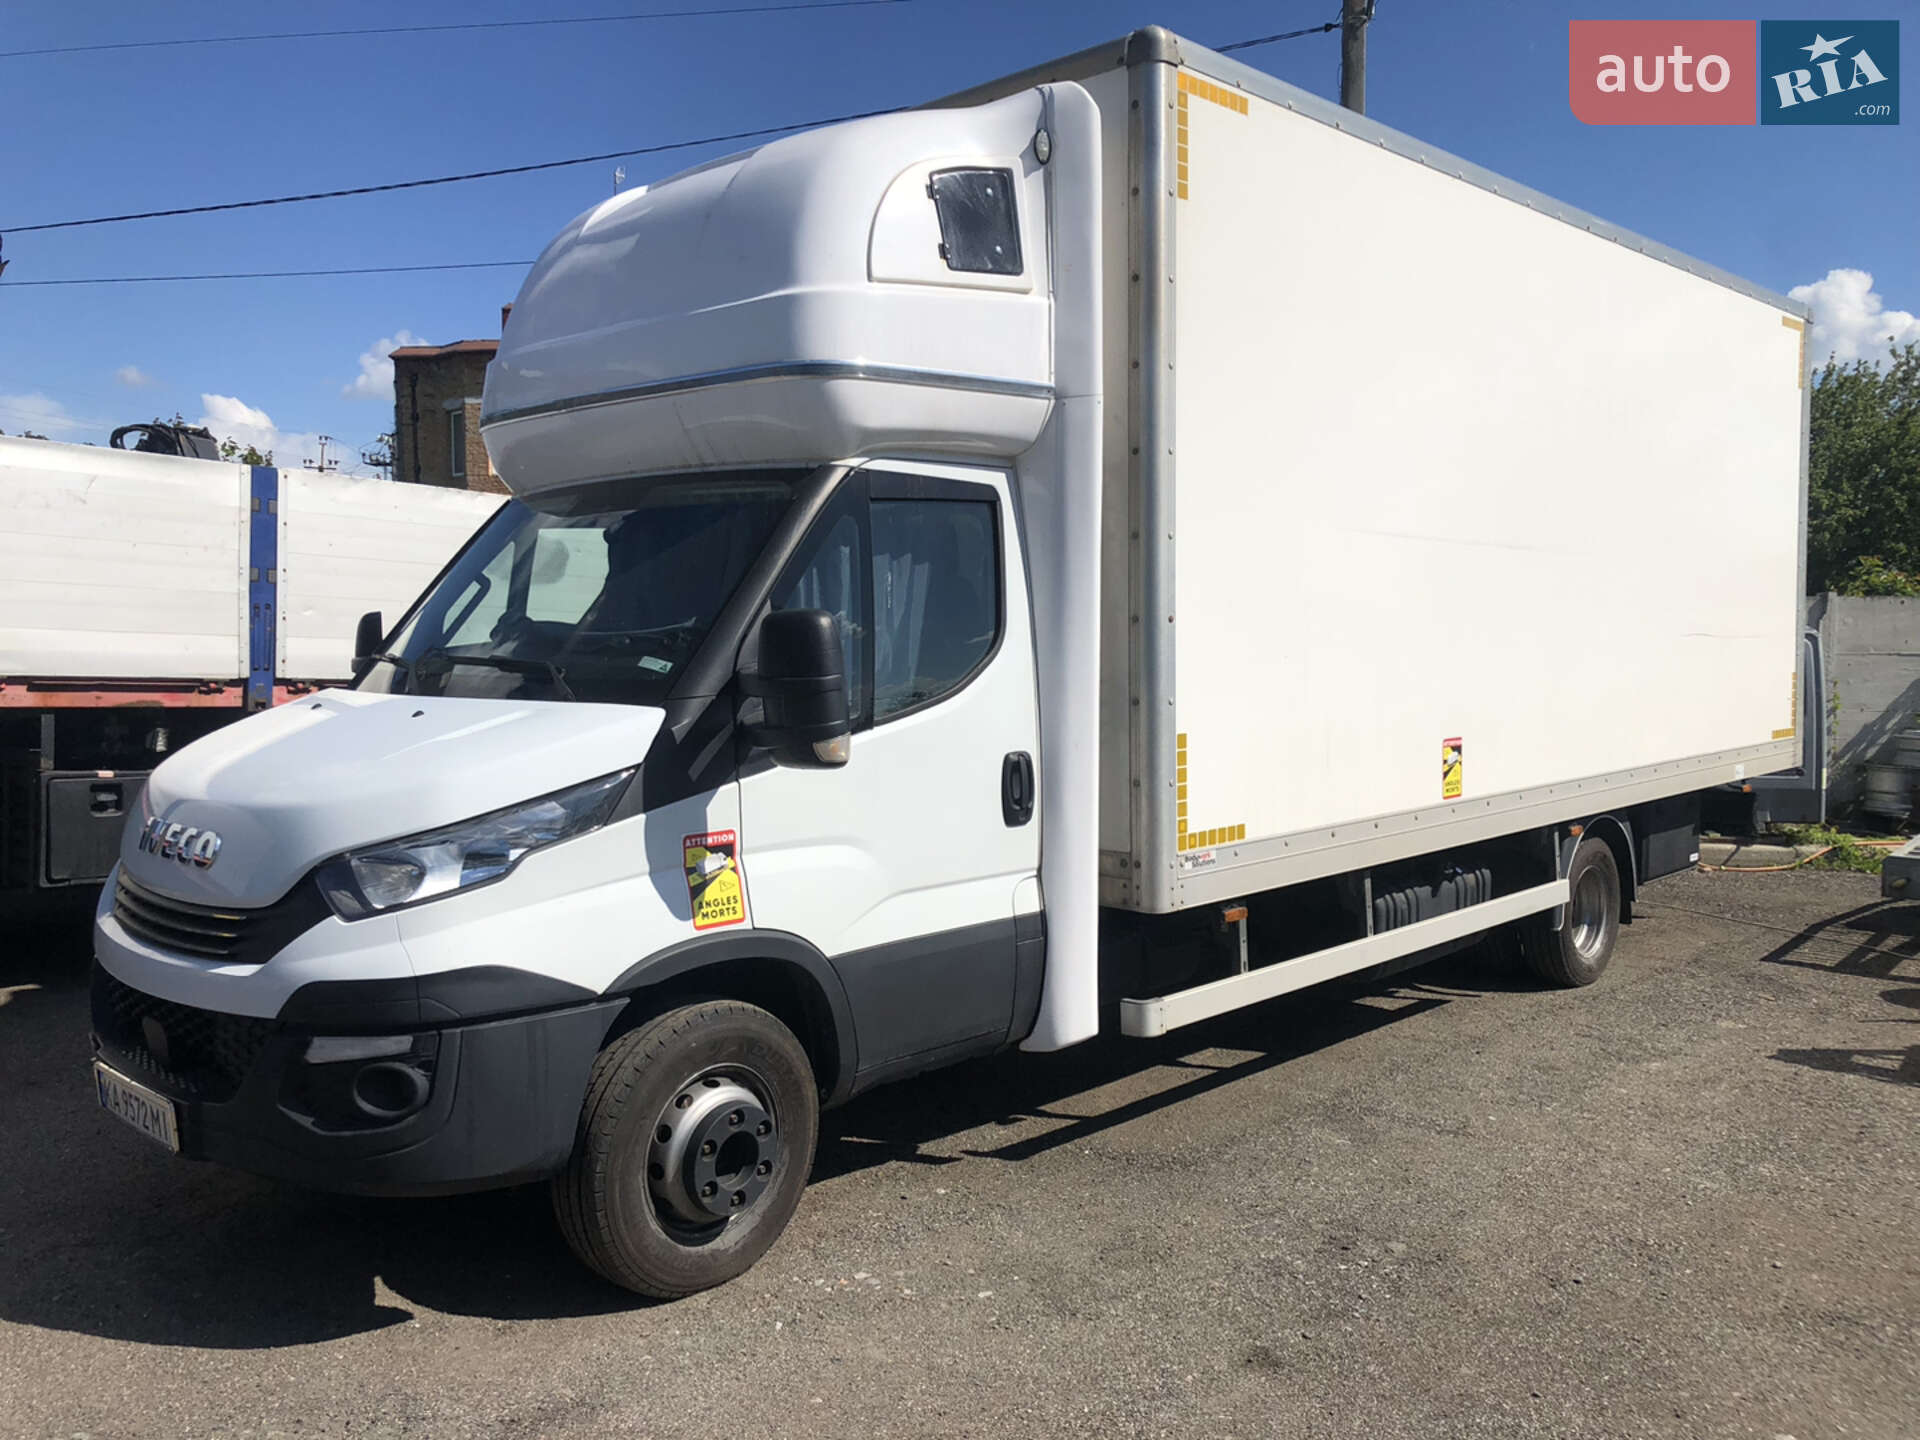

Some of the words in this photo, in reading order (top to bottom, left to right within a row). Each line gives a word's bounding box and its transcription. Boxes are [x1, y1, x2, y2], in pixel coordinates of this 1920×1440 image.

[139, 816, 222, 870] IVECO
[685, 833, 735, 848] ATTENTION
[698, 895, 739, 911] ANGLES
[701, 906, 739, 921] MORTS
